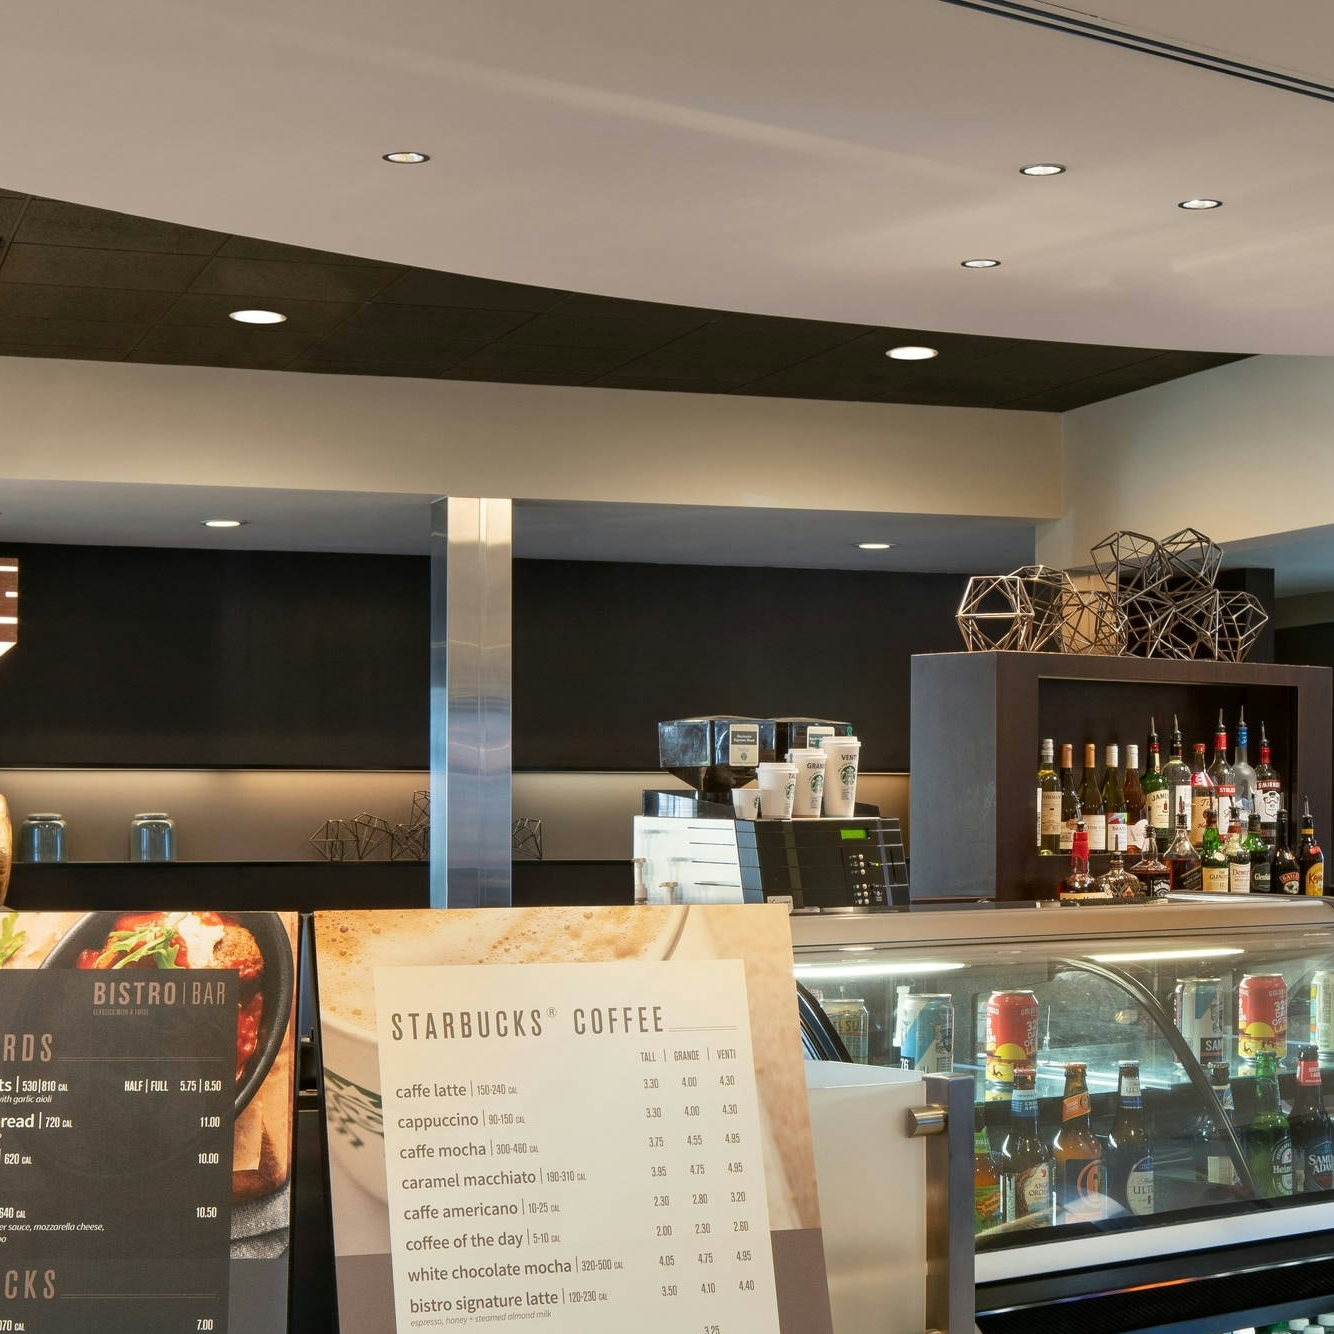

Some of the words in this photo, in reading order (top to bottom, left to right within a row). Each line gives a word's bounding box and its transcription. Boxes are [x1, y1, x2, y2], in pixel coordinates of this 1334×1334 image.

[573, 1006, 663, 1035] COFFEE
[640, 1052, 657, 1062] TALL
[673, 1050, 699, 1061] GRANDE
[716, 1049, 736, 1060] VENTI
[396, 1083, 431, 1099] caffe
[434, 1083, 467, 1097] latte
[643, 1078, 660, 1089] 3.30
[681, 1076, 697, 1087] 4.00
[719, 1075, 735, 1086] 4.30
[200, 1116, 220, 1128] 11.00
[397, 1112, 479, 1132] cappuccino
[400, 1143, 435, 1159] caffe
[438, 1142, 486, 1157] mocha
[402, 1173, 460, 1190] caramel
[463, 1170, 536, 1187] macchiato
[404, 1204, 439, 1220] caffe
[443, 1202, 518, 1218] americano
[406, 1235, 450, 1251] coffee
[453, 1233, 468, 1249] of
[470, 1233, 494, 1248] the
[498, 1231, 523, 1249] day
[408, 1266, 448, 1282] white
[452, 1263, 521, 1280] chocolate
[524, 1259, 572, 1275] mocha
[410, 1298, 452, 1313] bistro
[456, 1295, 523, 1314] signature
[526, 1291, 558, 1306] latte
